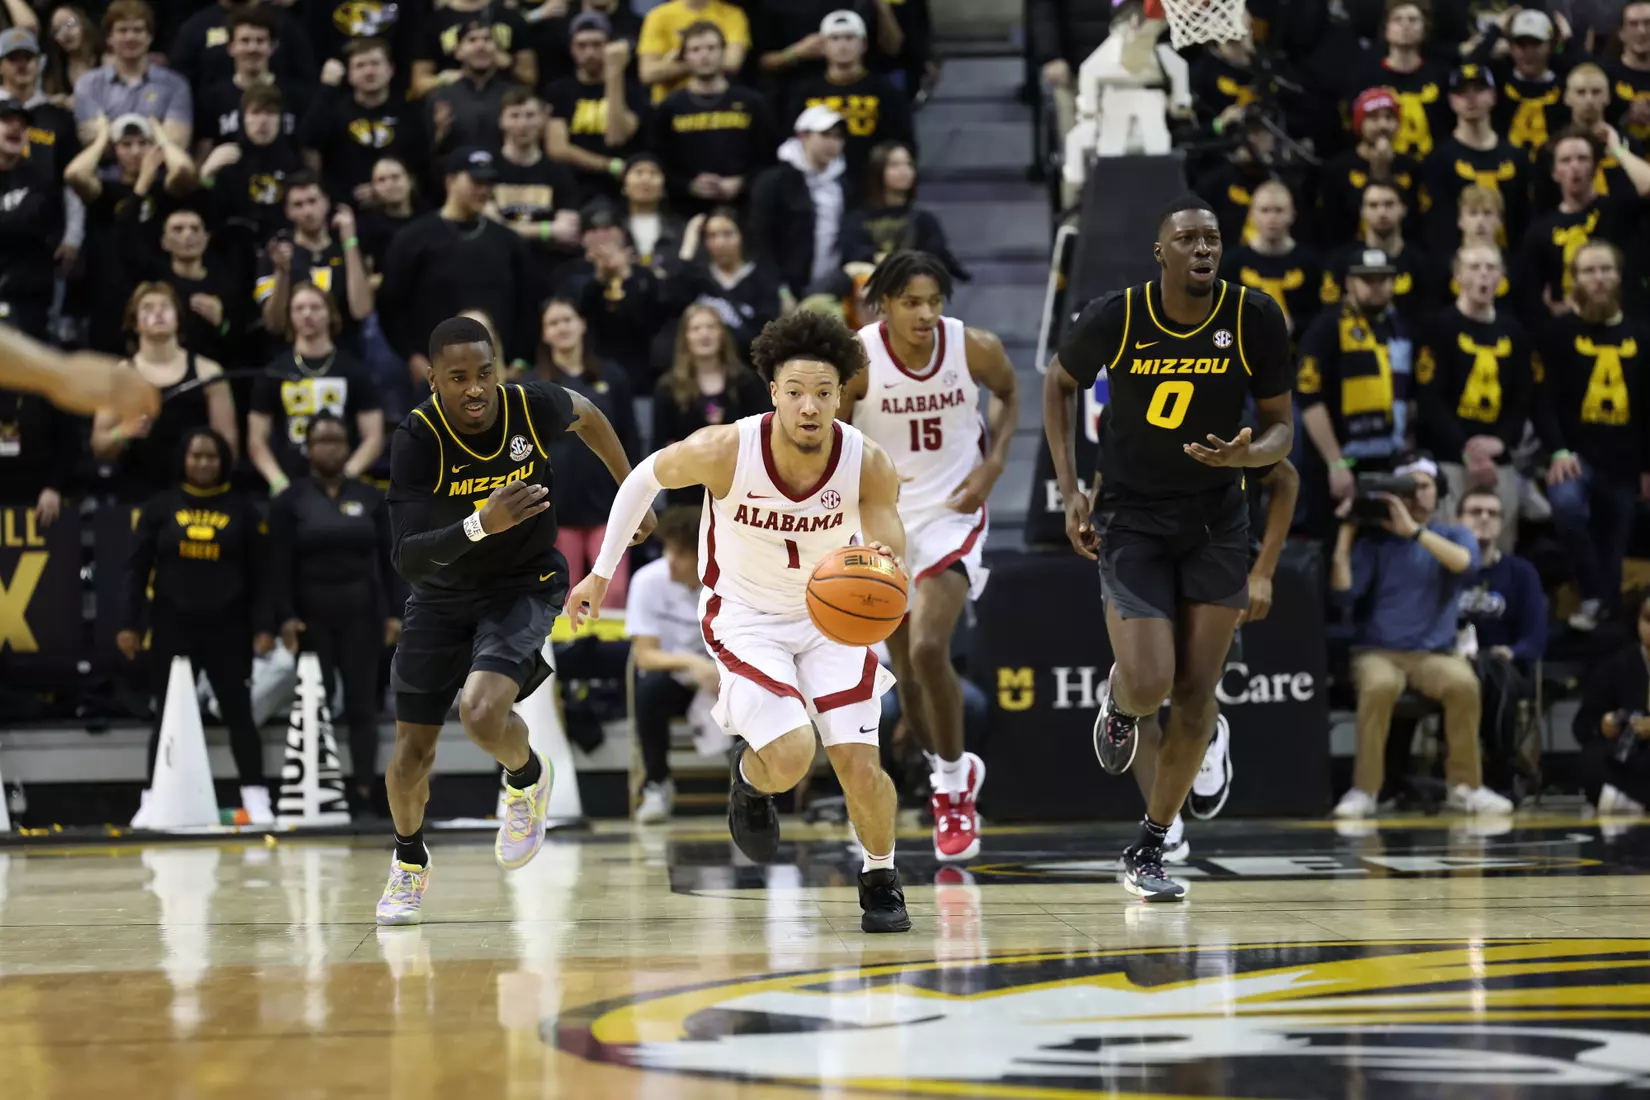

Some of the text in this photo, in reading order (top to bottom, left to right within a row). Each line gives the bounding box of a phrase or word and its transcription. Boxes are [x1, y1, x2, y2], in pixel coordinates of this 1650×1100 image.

[1214, 330, 1231, 347] SEC
[1130, 358, 1230, 375] MIZZOU
[881, 388, 965, 414] ALABAMA
[1146, 381, 1194, 429] 0
[511, 436, 528, 455] SEC
[909, 416, 942, 452] 15
[448, 461, 535, 497] MIZZOU
[821, 490, 840, 509] SEC
[733, 503, 844, 532] ALABAMA
[784, 538, 800, 569] 1
[1215, 662, 1315, 704] Care
